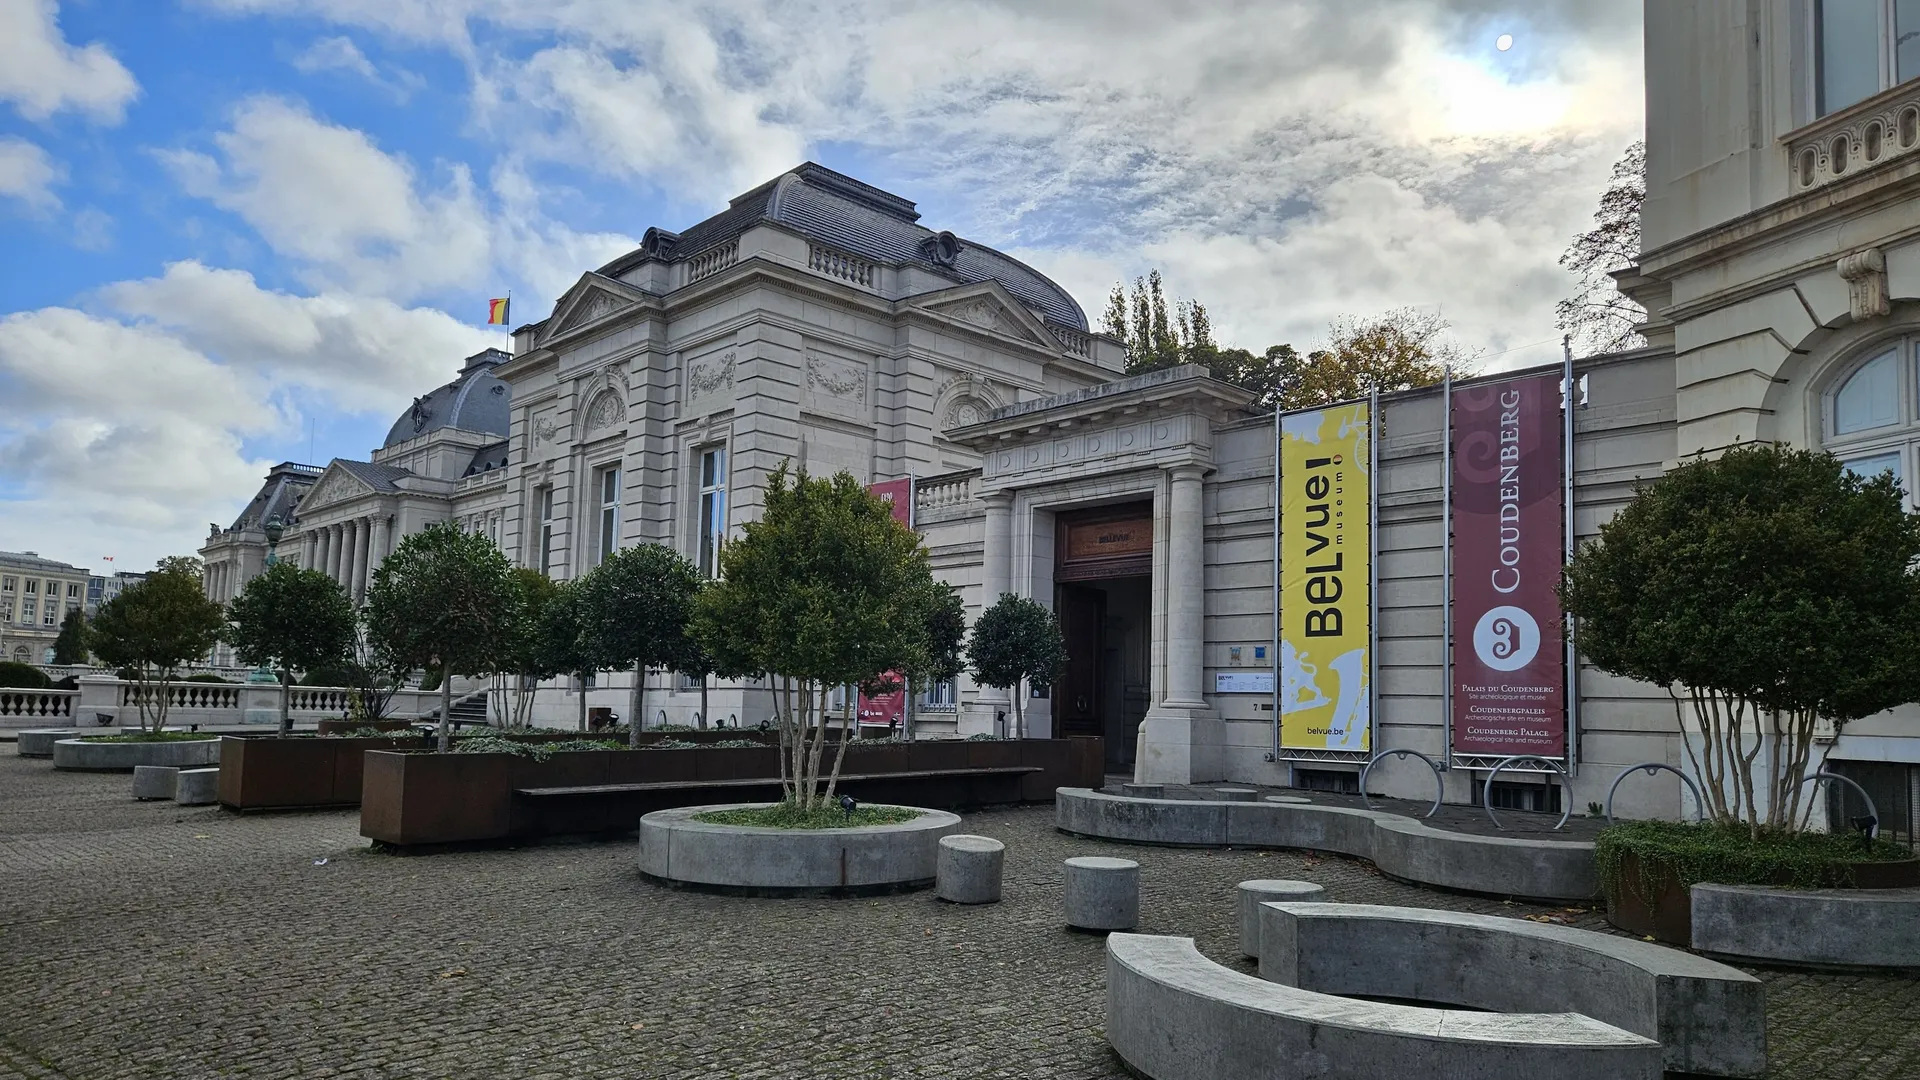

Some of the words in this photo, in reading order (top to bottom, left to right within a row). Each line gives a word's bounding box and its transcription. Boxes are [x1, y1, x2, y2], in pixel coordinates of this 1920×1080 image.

[1491, 389, 1521, 594] COUDENBERG
[1335, 471, 1343, 545] museum
[1462, 684, 1486, 692] PALAIS
[1500, 684, 1554, 693] COUDENBERG
[1480, 693, 1519, 701] archéologique
[1470, 705, 1546, 715] COUDENBERGPALEIS
[1464, 714, 1506, 722] Archeologische
[1307, 726, 1344, 736] belvue.be
[1467, 726, 1519, 735] COUDENBERG
[1520, 727, 1549, 737] PALACE
[1463, 735, 1504, 743] Archaeological
[1527, 737, 1553, 745] museum
